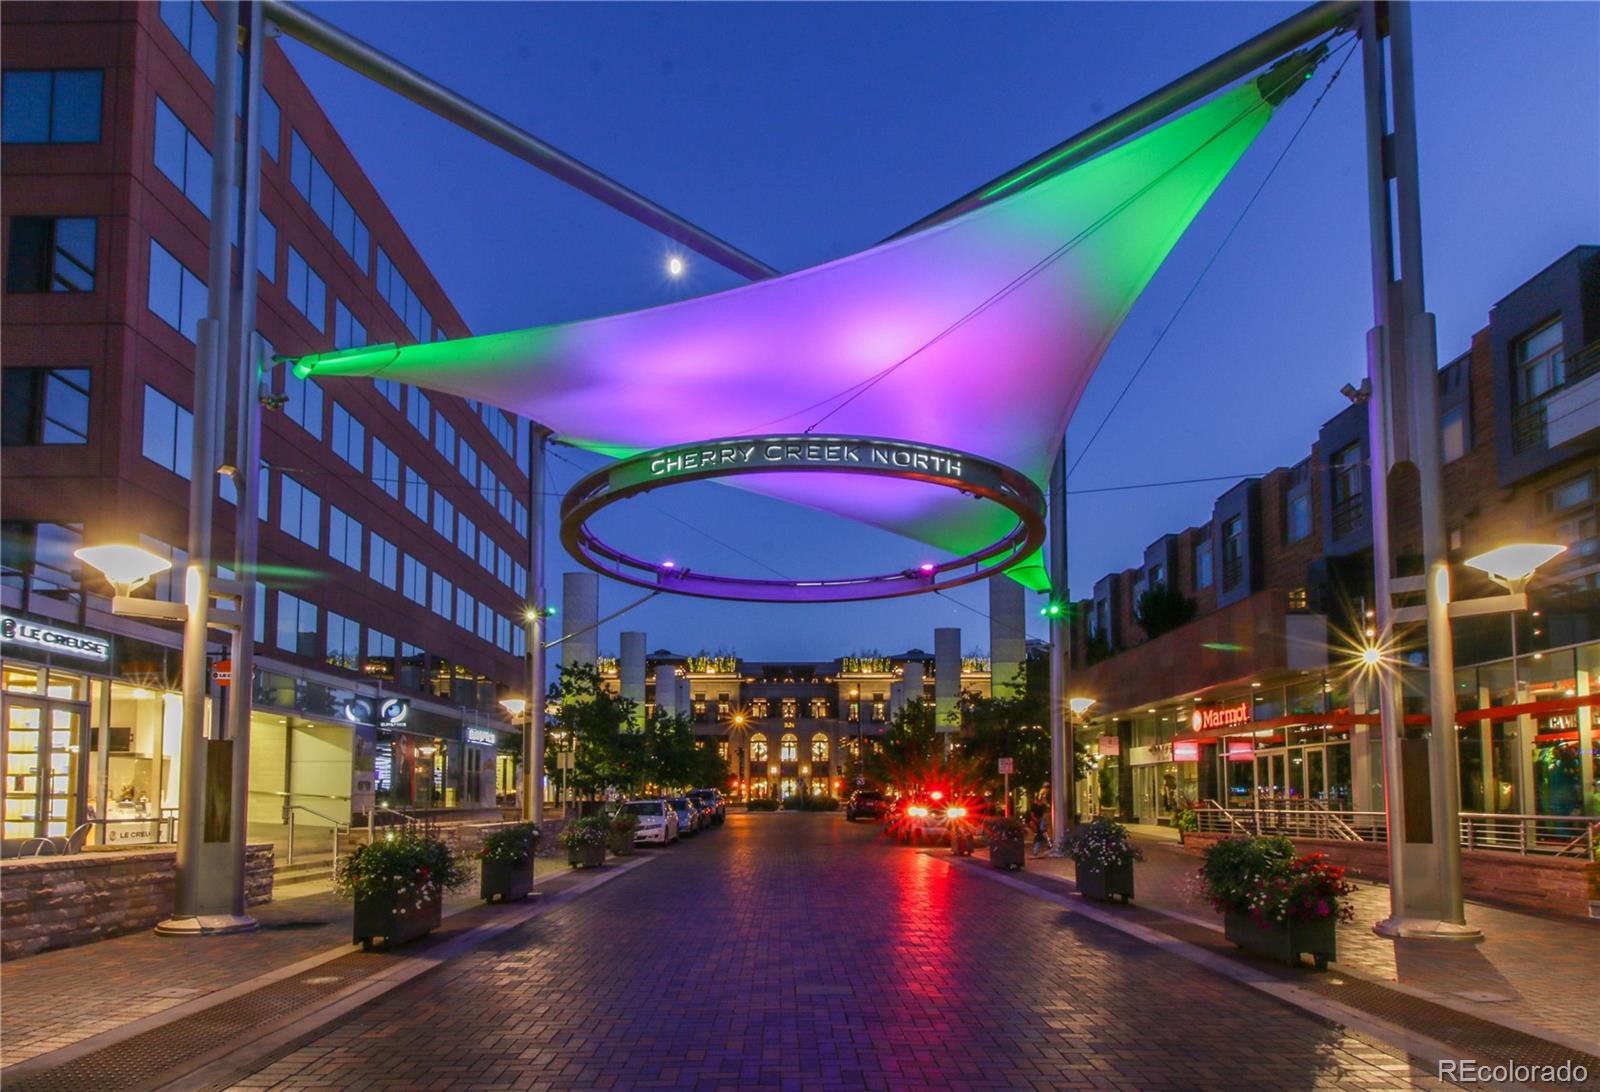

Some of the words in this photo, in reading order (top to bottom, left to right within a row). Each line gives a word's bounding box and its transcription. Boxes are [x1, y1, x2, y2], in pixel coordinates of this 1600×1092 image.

[651, 447, 755, 475] CHERRY
[764, 446, 859, 462] CREEK
[872, 448, 961, 477] NORTH
[20, 625, 40, 641] LE
[42, 631, 110, 656] CREUSET
[1203, 702, 1248, 729] Marmot
[120, 831, 129, 839] LE
